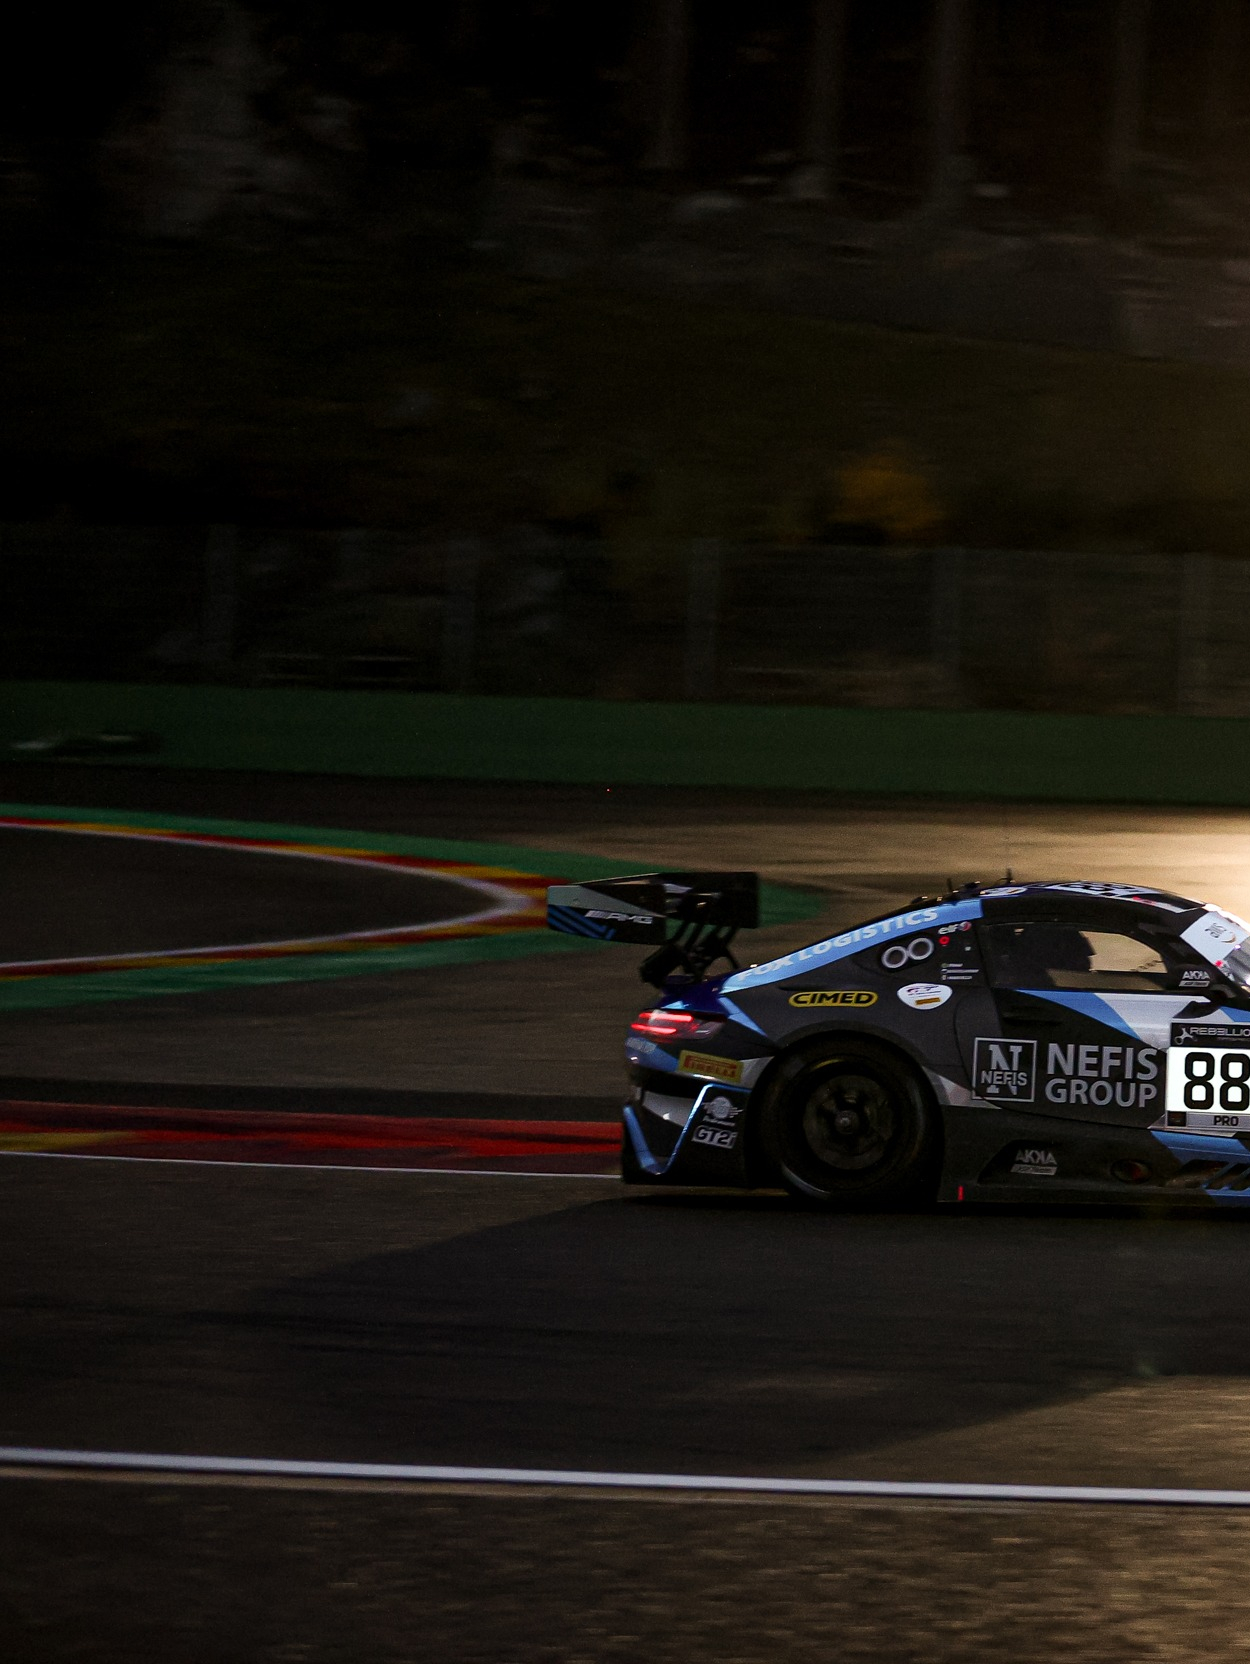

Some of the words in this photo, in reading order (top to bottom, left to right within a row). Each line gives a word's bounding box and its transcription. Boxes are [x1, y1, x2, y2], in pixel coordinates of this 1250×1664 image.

[737, 957, 794, 981] FOX
[798, 908, 939, 961] LOGISTICS
[793, 993, 874, 1004] CIMED
[1046, 1042, 1159, 1081] NEFIS
[980, 1070, 1028, 1087] NEFIS
[1044, 1077, 1158, 1109] GROUP
[1184, 1052, 1250, 1111] 88
[1213, 1116, 1239, 1126] PRO
